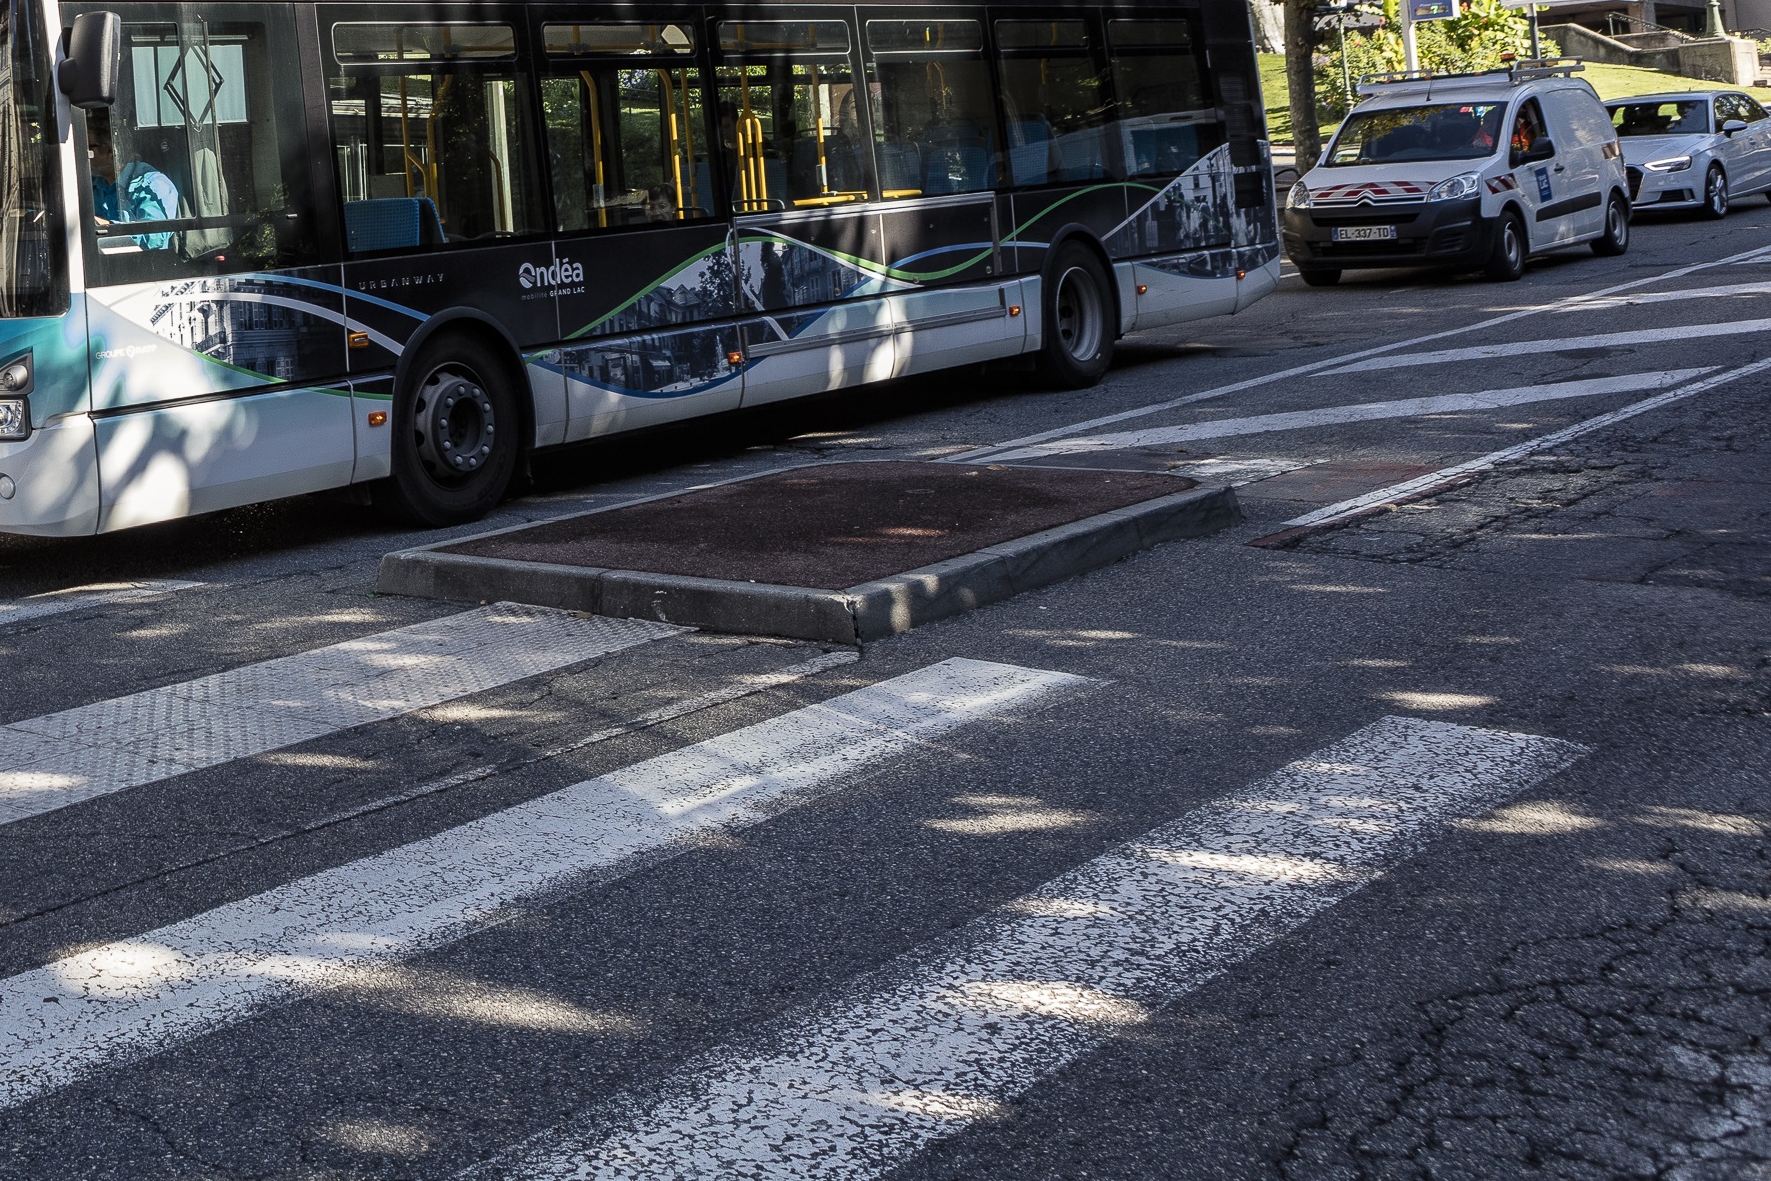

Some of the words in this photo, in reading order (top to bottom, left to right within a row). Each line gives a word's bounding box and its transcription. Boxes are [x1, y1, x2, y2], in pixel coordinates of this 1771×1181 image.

[1339, 227, 1389, 239] EL-337-TD
[518, 257, 584, 289] Ondéa
[358, 273, 444, 290] URBANWAY
[572, 286, 586, 294] LAC
[95, 348, 126, 360] GROUPE
